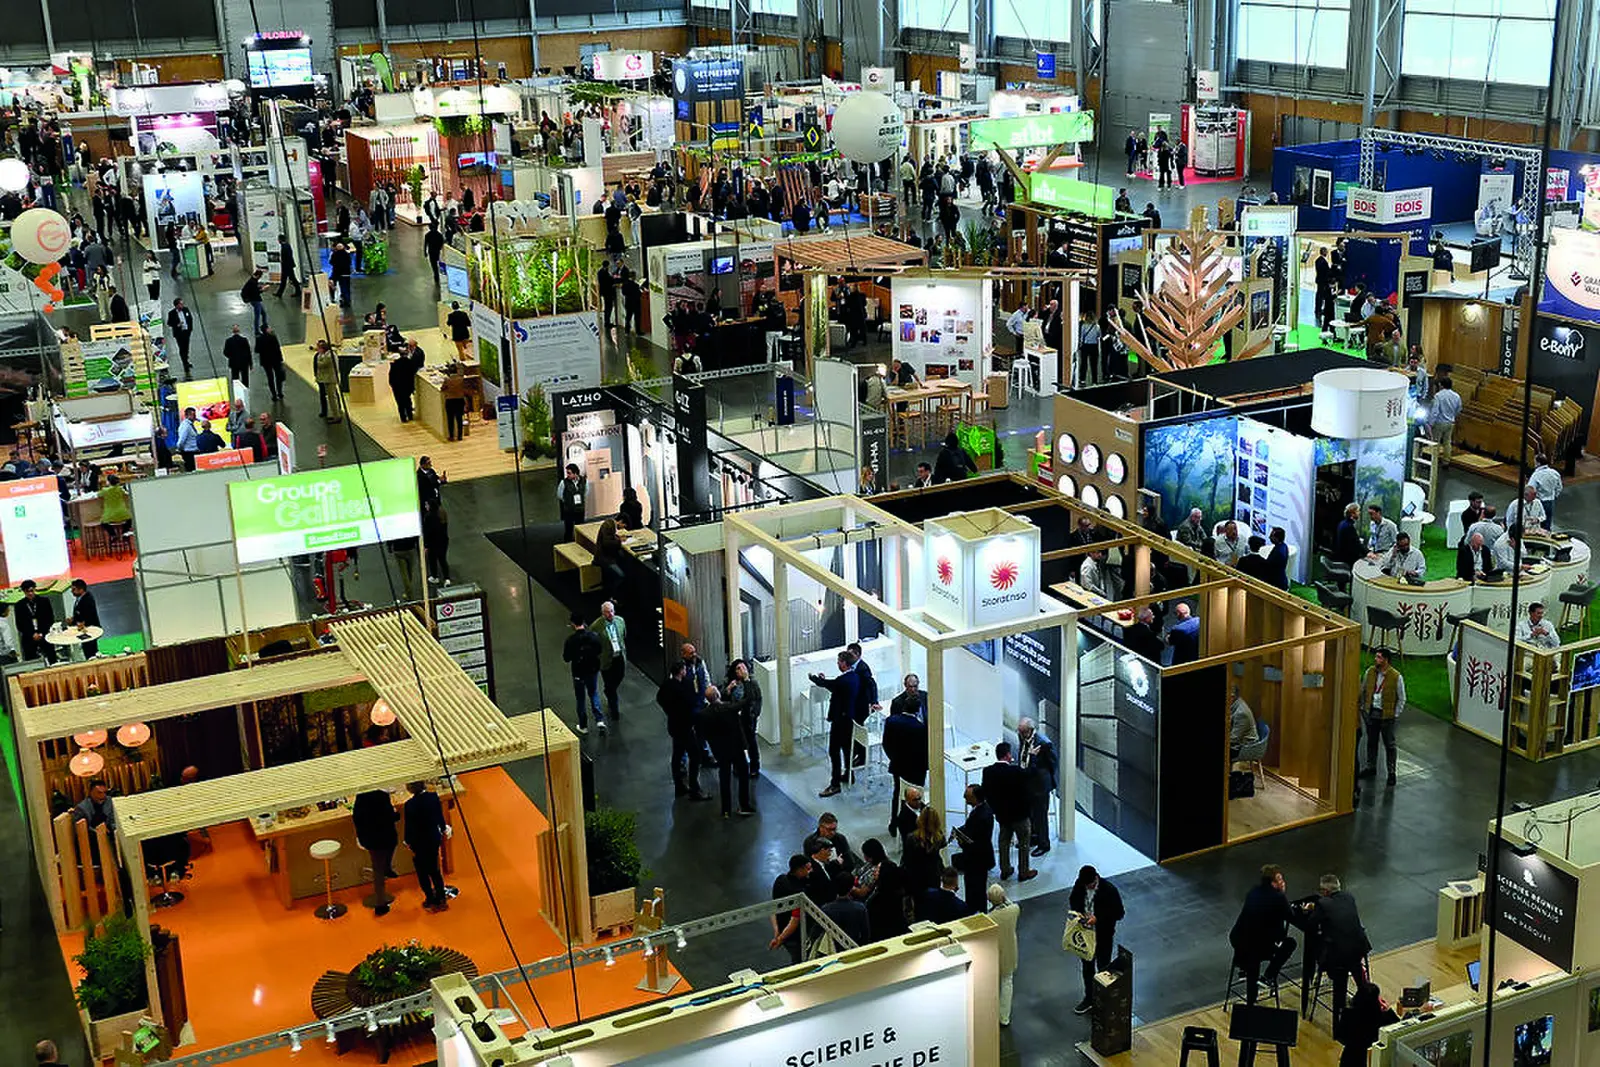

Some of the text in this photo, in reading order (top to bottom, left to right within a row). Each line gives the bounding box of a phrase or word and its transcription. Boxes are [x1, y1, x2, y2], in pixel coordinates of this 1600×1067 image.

[1353, 199, 1377, 213] BOIS
[1395, 199, 1423, 214] BOIS
[1503, 335, 1512, 377] FLOOR
[561, 391, 602, 406] LATHO
[257, 479, 342, 503] Groupe
[786, 1026, 897, 1067] SCIERIE &
